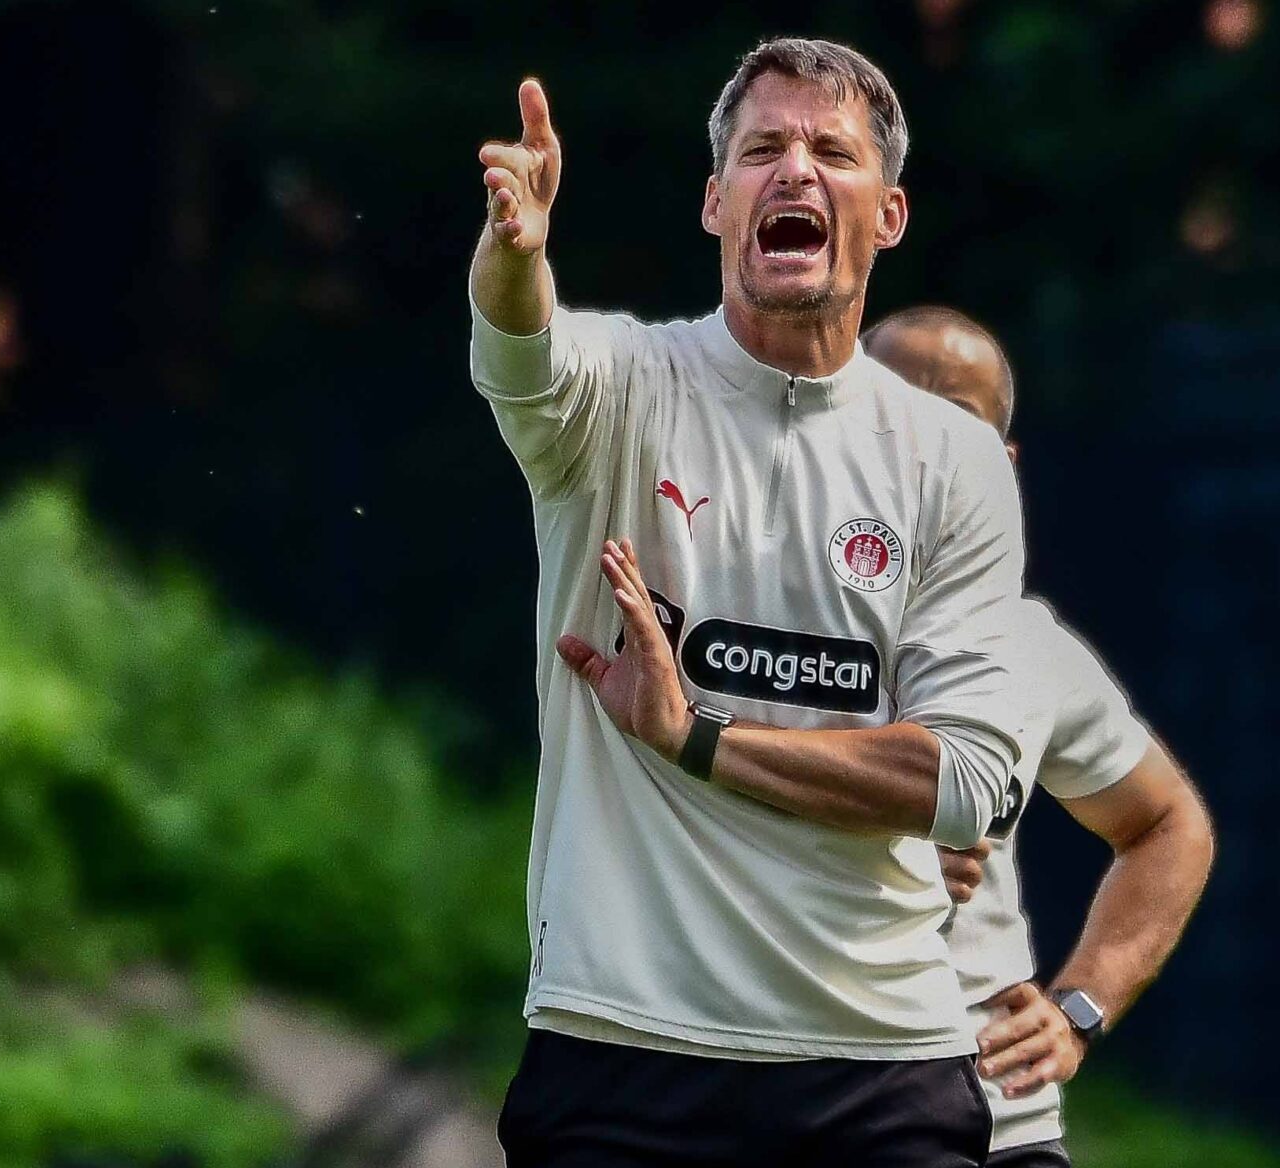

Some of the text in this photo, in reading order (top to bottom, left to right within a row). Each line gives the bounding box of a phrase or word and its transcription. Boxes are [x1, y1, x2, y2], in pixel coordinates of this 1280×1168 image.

[834, 522, 901, 562] FC ST. PAULI
[848, 574, 875, 589] 1910
[705, 642, 873, 692] congstar
